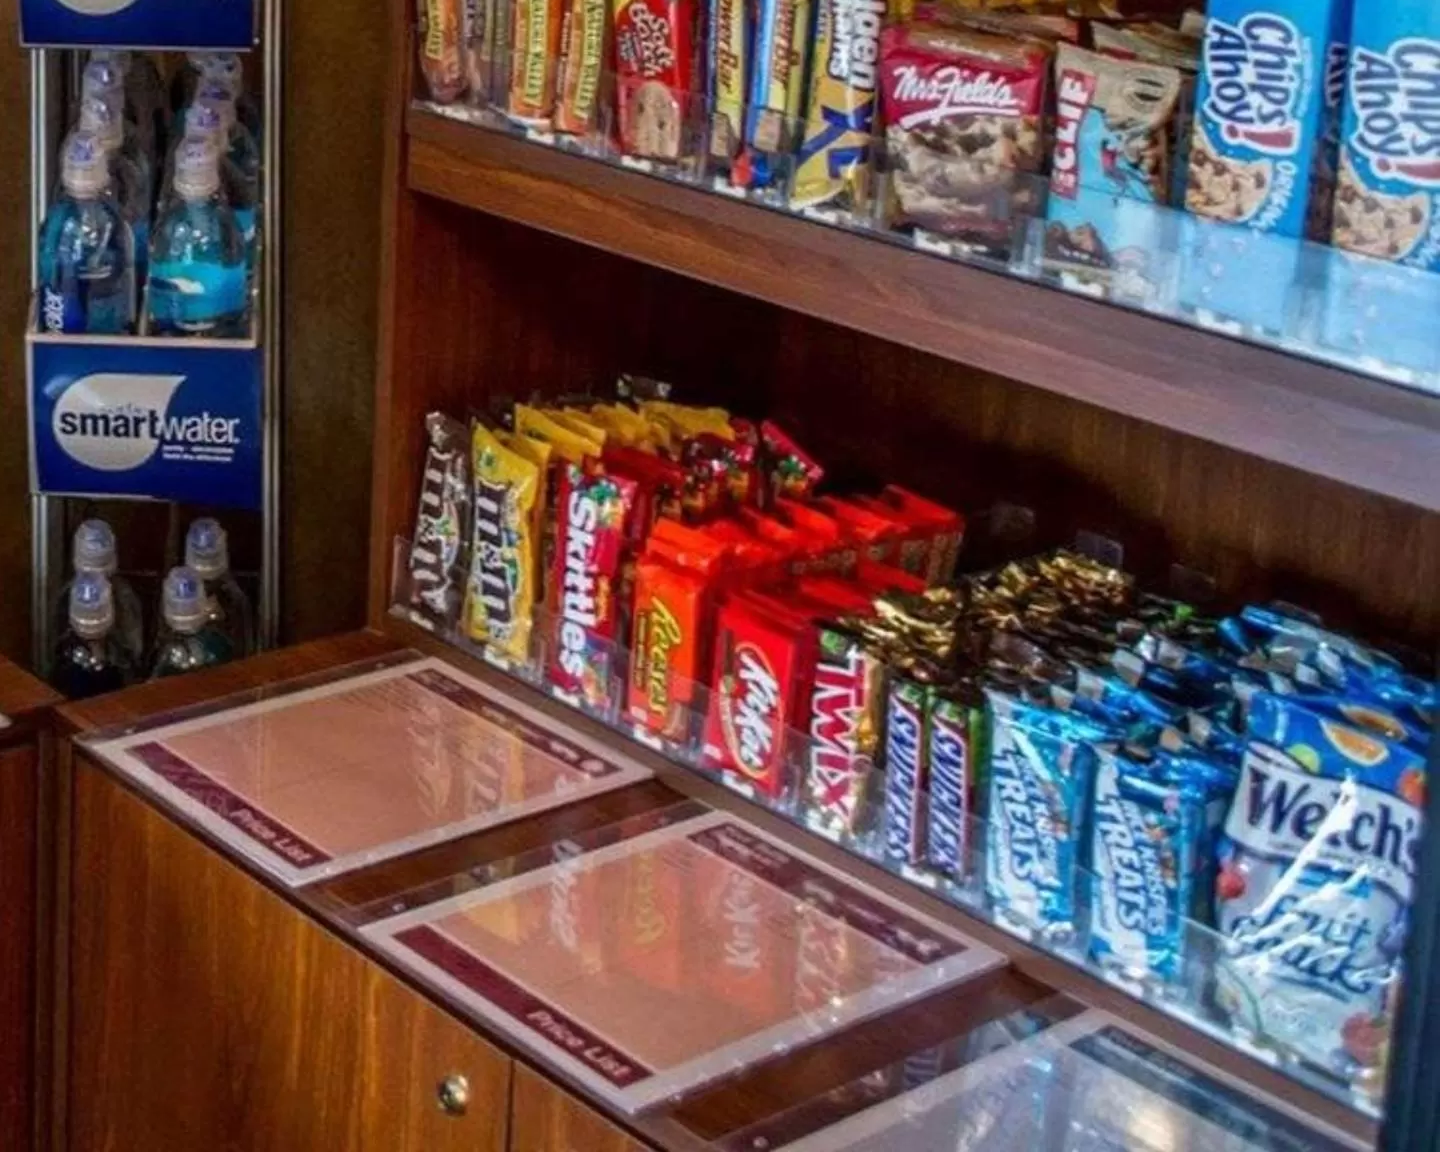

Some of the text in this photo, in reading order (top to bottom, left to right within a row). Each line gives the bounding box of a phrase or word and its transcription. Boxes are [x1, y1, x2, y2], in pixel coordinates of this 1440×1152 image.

[1054, 71, 1093, 174] CLIF
[1242, 16, 1299, 129] Chips
[560, 491, 599, 678] Skittles
[228, 805, 315, 864] Price List
[887, 696, 921, 861] SNICKERS
[930, 711, 967, 874] SNICKERS
[991, 753, 1039, 881] TREATS
[1247, 764, 1418, 878] Wech'
[1096, 798, 1147, 932] TREATS
[526, 1007, 633, 1080] Price List
